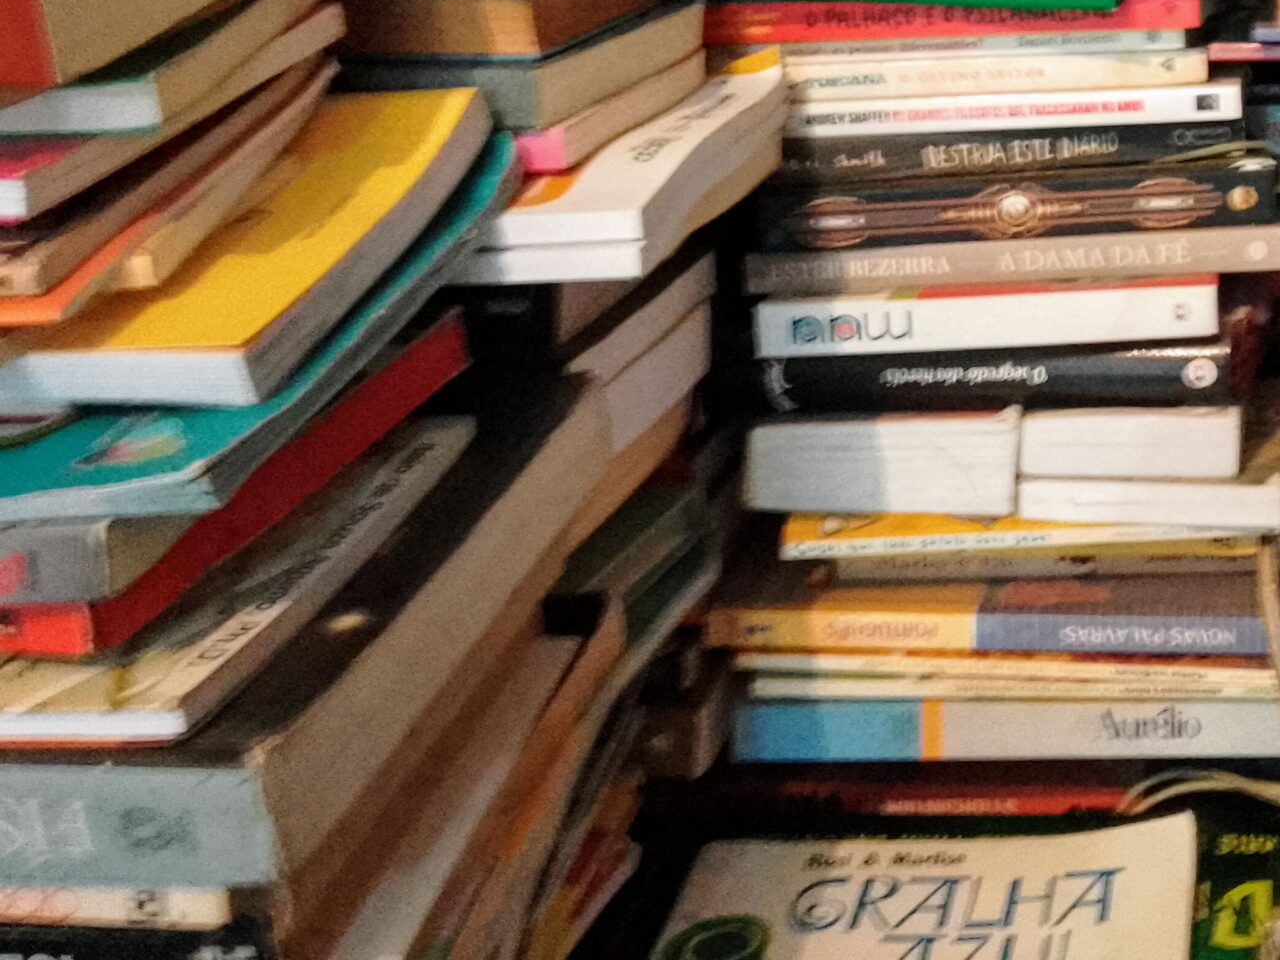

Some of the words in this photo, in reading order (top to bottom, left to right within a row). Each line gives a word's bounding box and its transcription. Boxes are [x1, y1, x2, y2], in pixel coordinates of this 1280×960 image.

[920, 141, 1006, 170] DESTRUA
[1007, 137, 1056, 163] ESTE
[848, 254, 952, 279] BEZERRA
[999, 251, 1016, 273] A
[1018, 246, 1104, 272] DAMA
[1112, 244, 1151, 266] DA
[1158, 238, 1192, 263] FÉ
[1058, 624, 1166, 647] PALAVRAS
[1167, 625, 1238, 647] NOVAS
[1096, 705, 1202, 741] Aurélio
[788, 867, 1127, 933] GRALHA
